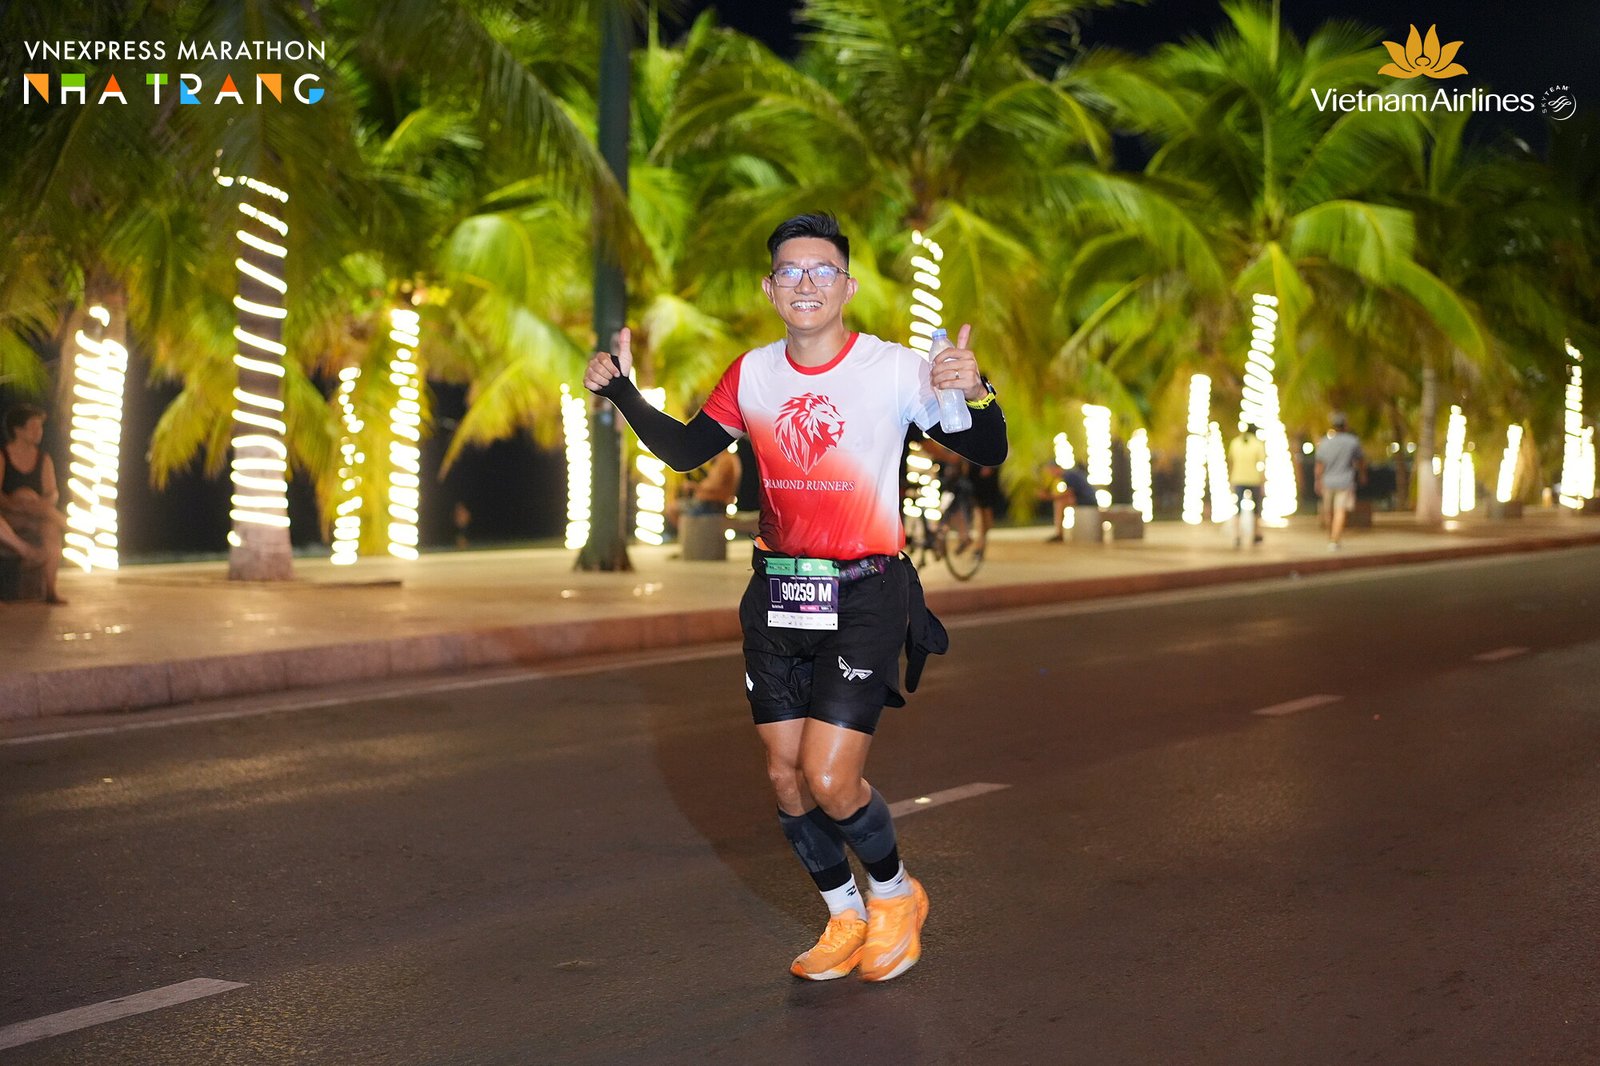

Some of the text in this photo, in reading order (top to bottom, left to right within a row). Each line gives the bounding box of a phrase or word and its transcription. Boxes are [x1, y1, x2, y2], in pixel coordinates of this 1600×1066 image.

[806, 480, 855, 491] RUNNERS
[781, 582, 832, 602] 90259 M
